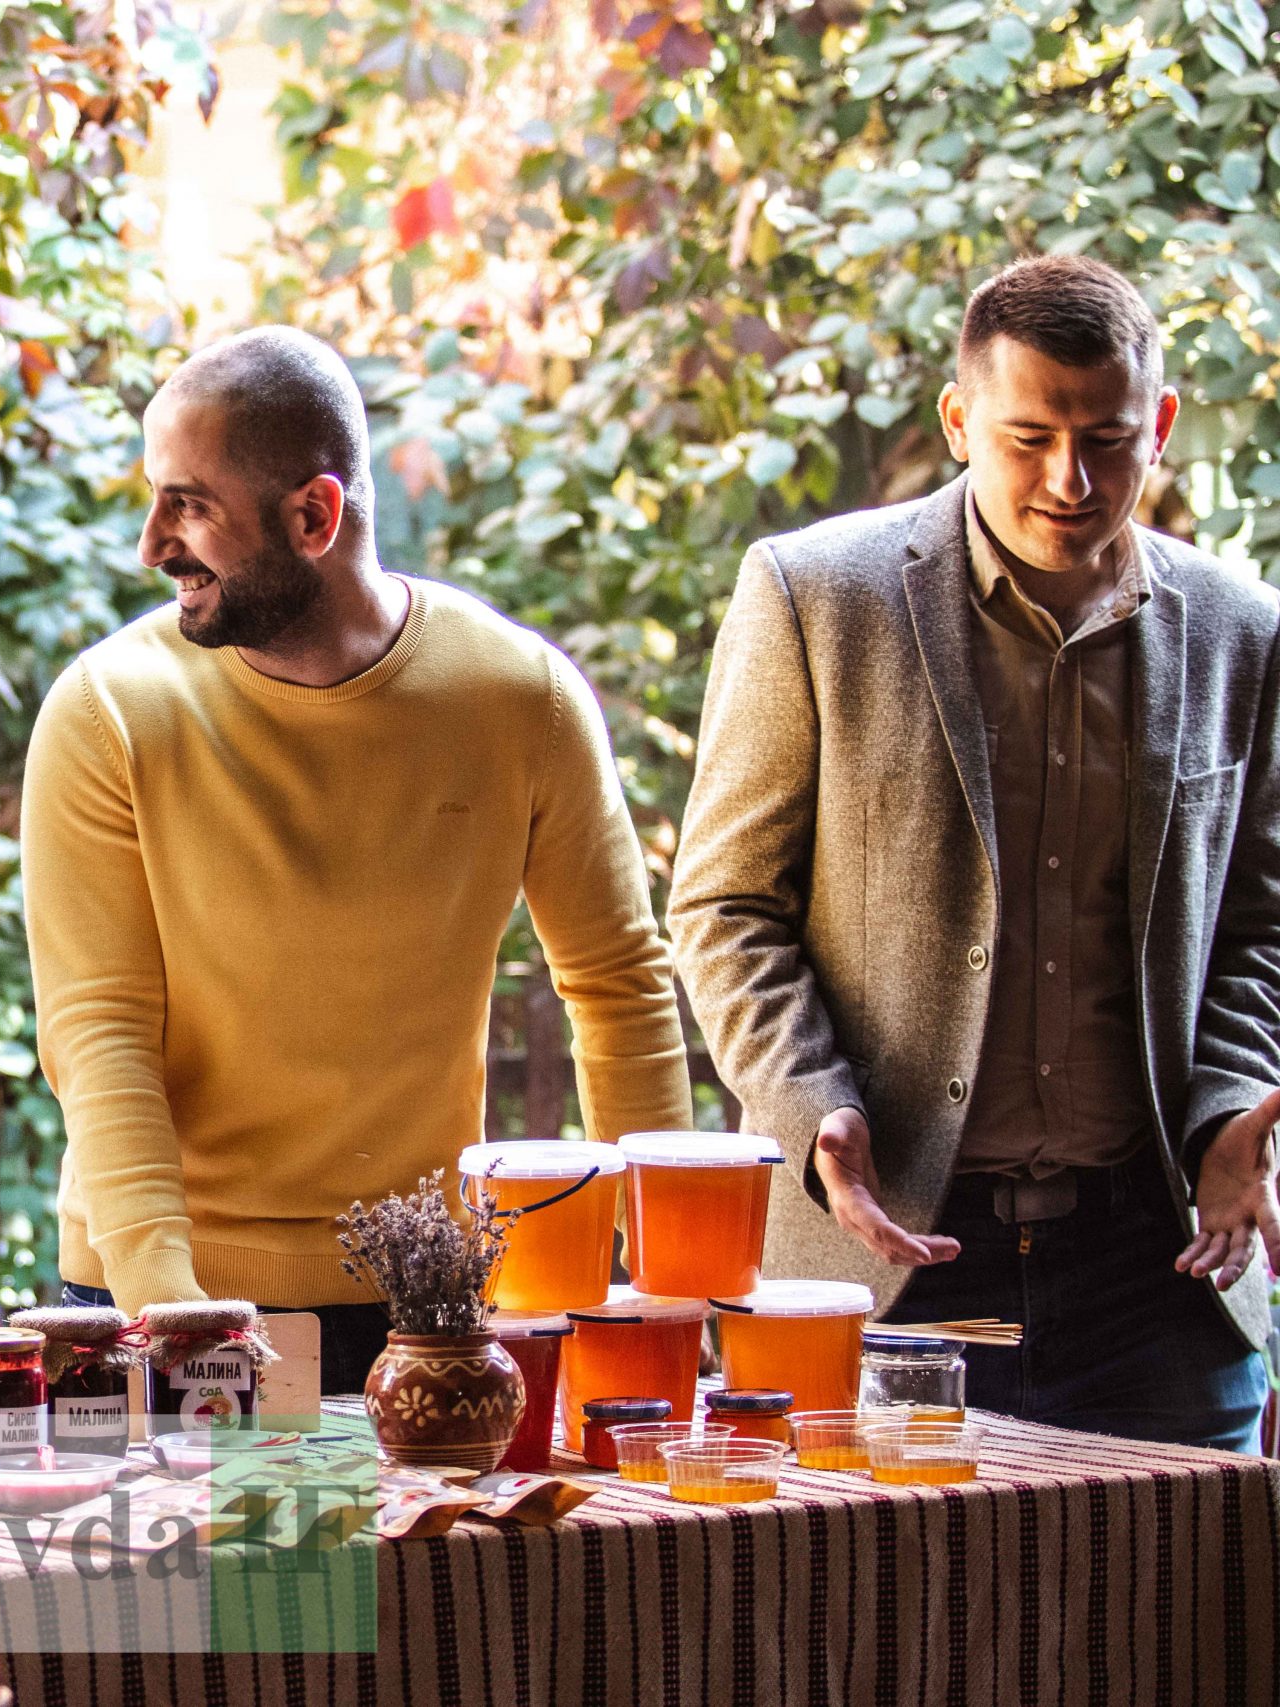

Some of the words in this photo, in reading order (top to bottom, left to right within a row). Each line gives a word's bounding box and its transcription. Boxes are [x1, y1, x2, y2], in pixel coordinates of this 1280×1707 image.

[183, 1360, 242, 1380] МАЛИНА
[7, 1411, 37, 1427] СИРОП
[68, 1406, 123, 1427] МАЛИНА
[1, 1429, 40, 1443] МАЛИНА
